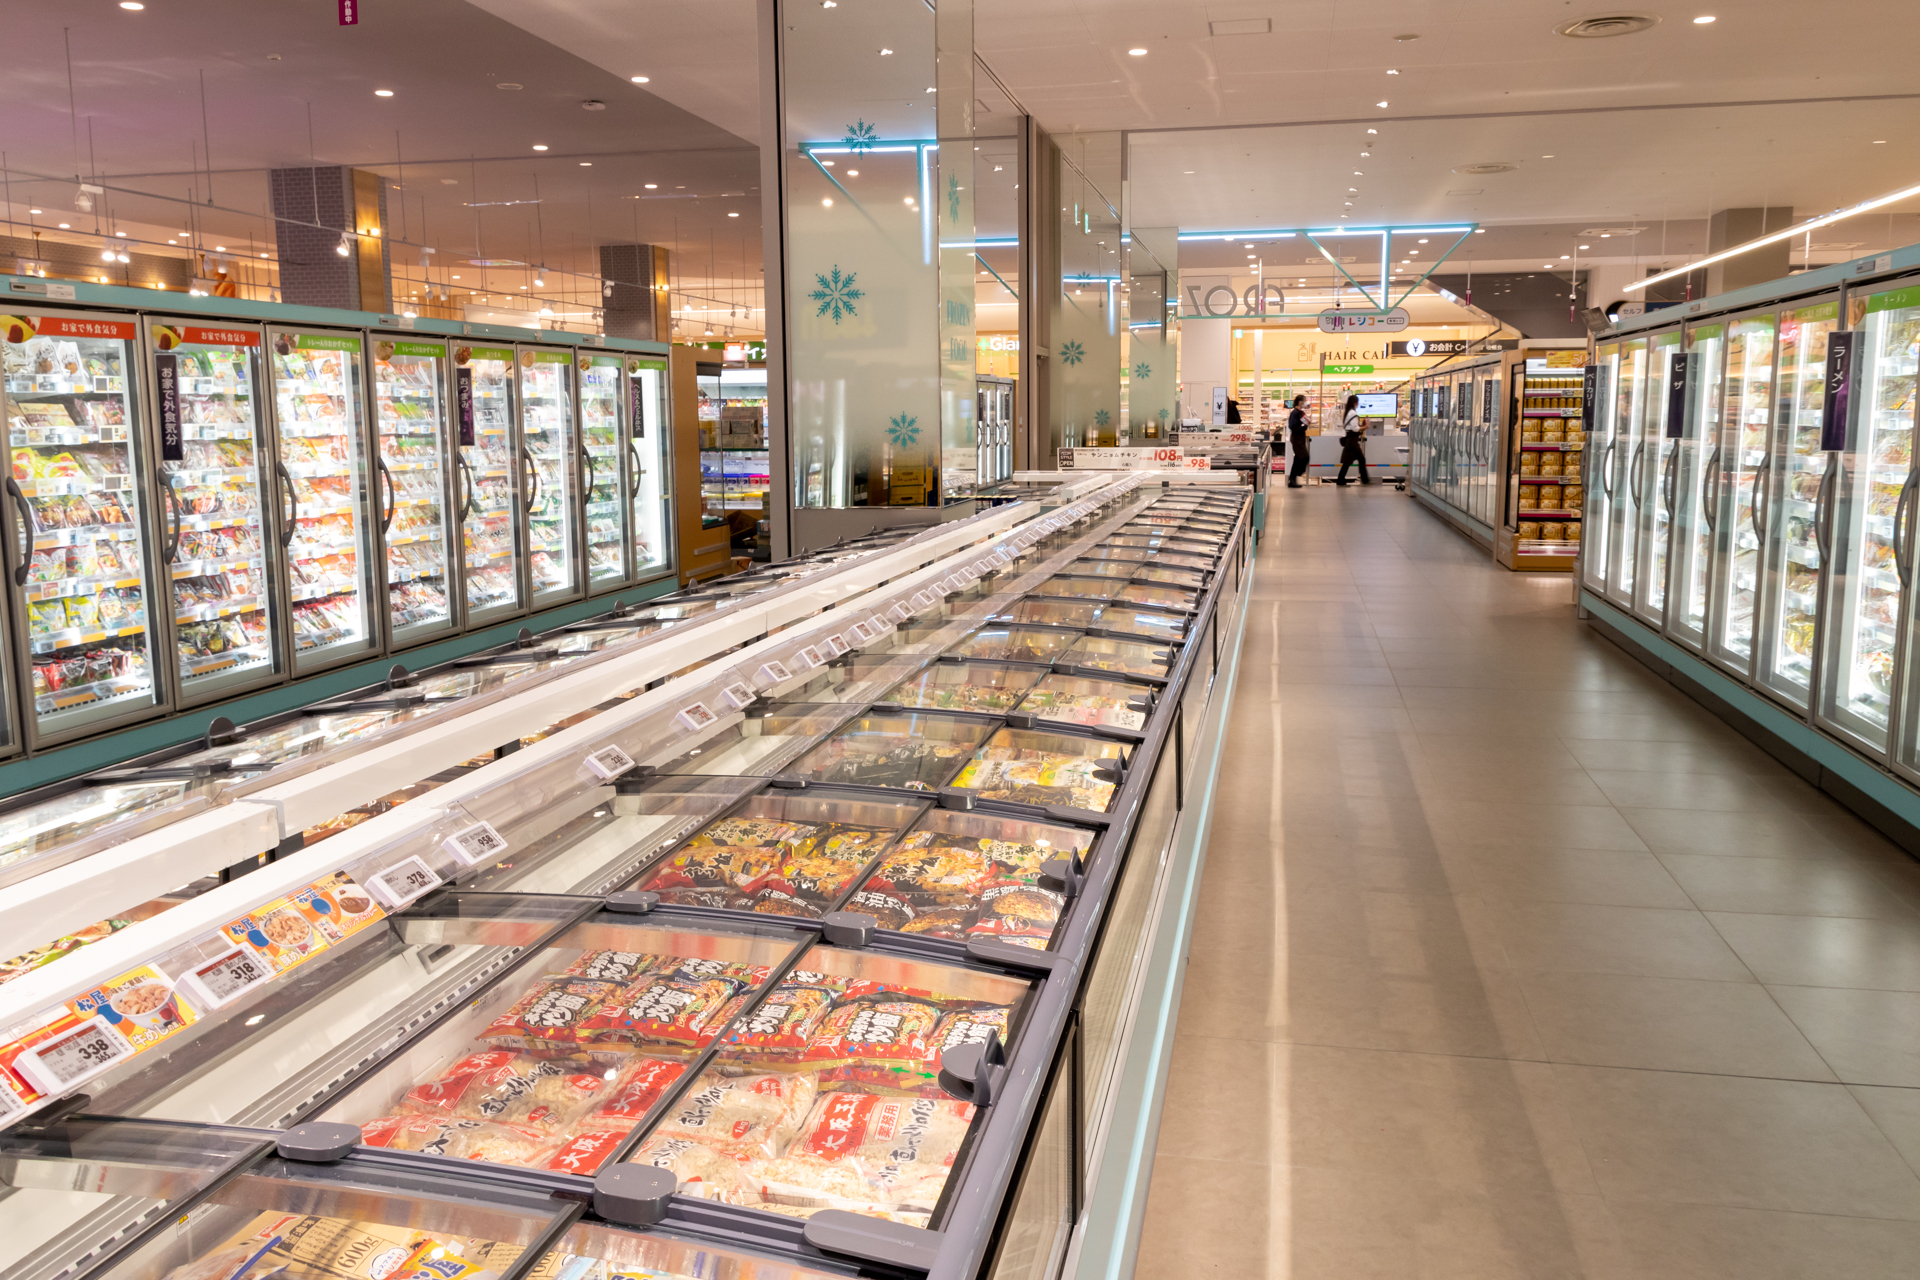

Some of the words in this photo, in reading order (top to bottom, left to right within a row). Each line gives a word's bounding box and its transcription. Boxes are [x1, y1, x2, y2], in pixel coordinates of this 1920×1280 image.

[61, 322, 118, 336] お家で外食気分
[201, 331, 247, 344] お家で外食気分
[1324, 351, 1357, 361] HAIR
[1429, 343, 1452, 351] お会計
[1673, 362, 1685, 390] ピザ
[1831, 346, 1846, 394] ラーメン
[460, 377, 469, 409] おつまみ
[1586, 372, 1594, 408] ベーカリー
[161, 367, 178, 446] お家で外食気分
[1153, 449, 1183, 462] 108円
[1191, 458, 1210, 468] 98円
[477, 834, 494, 847] 958
[407, 871, 426, 885] 378
[294, 887, 320, 904] 松屋
[229, 917, 257, 936] 松屋
[340, 908, 378, 931] オリジナルカレー
[230, 962, 255, 981] 318
[106, 973, 149, 998] の味をご家庭で!
[75, 989, 109, 1012] 松屋
[524, 989, 564, 1026] 本格炒め
[542, 994, 588, 1027] 炒飯
[645, 989, 692, 1023] 炒飯
[749, 1003, 792, 1035] 炒飯
[845, 1010, 876, 1043] 本格炒め
[864, 1011, 905, 1043] 炒飯
[132, 1020, 180, 1047] 牛めしの具
[78, 1039, 110, 1060] 338
[531, 1108, 548, 1120] 1kg
[821, 1094, 868, 1150] 大阪王将
[877, 1104, 899, 1139] 業務用
[734, 1120, 749, 1134] 1kg
[337, 1236, 380, 1269] 600g
